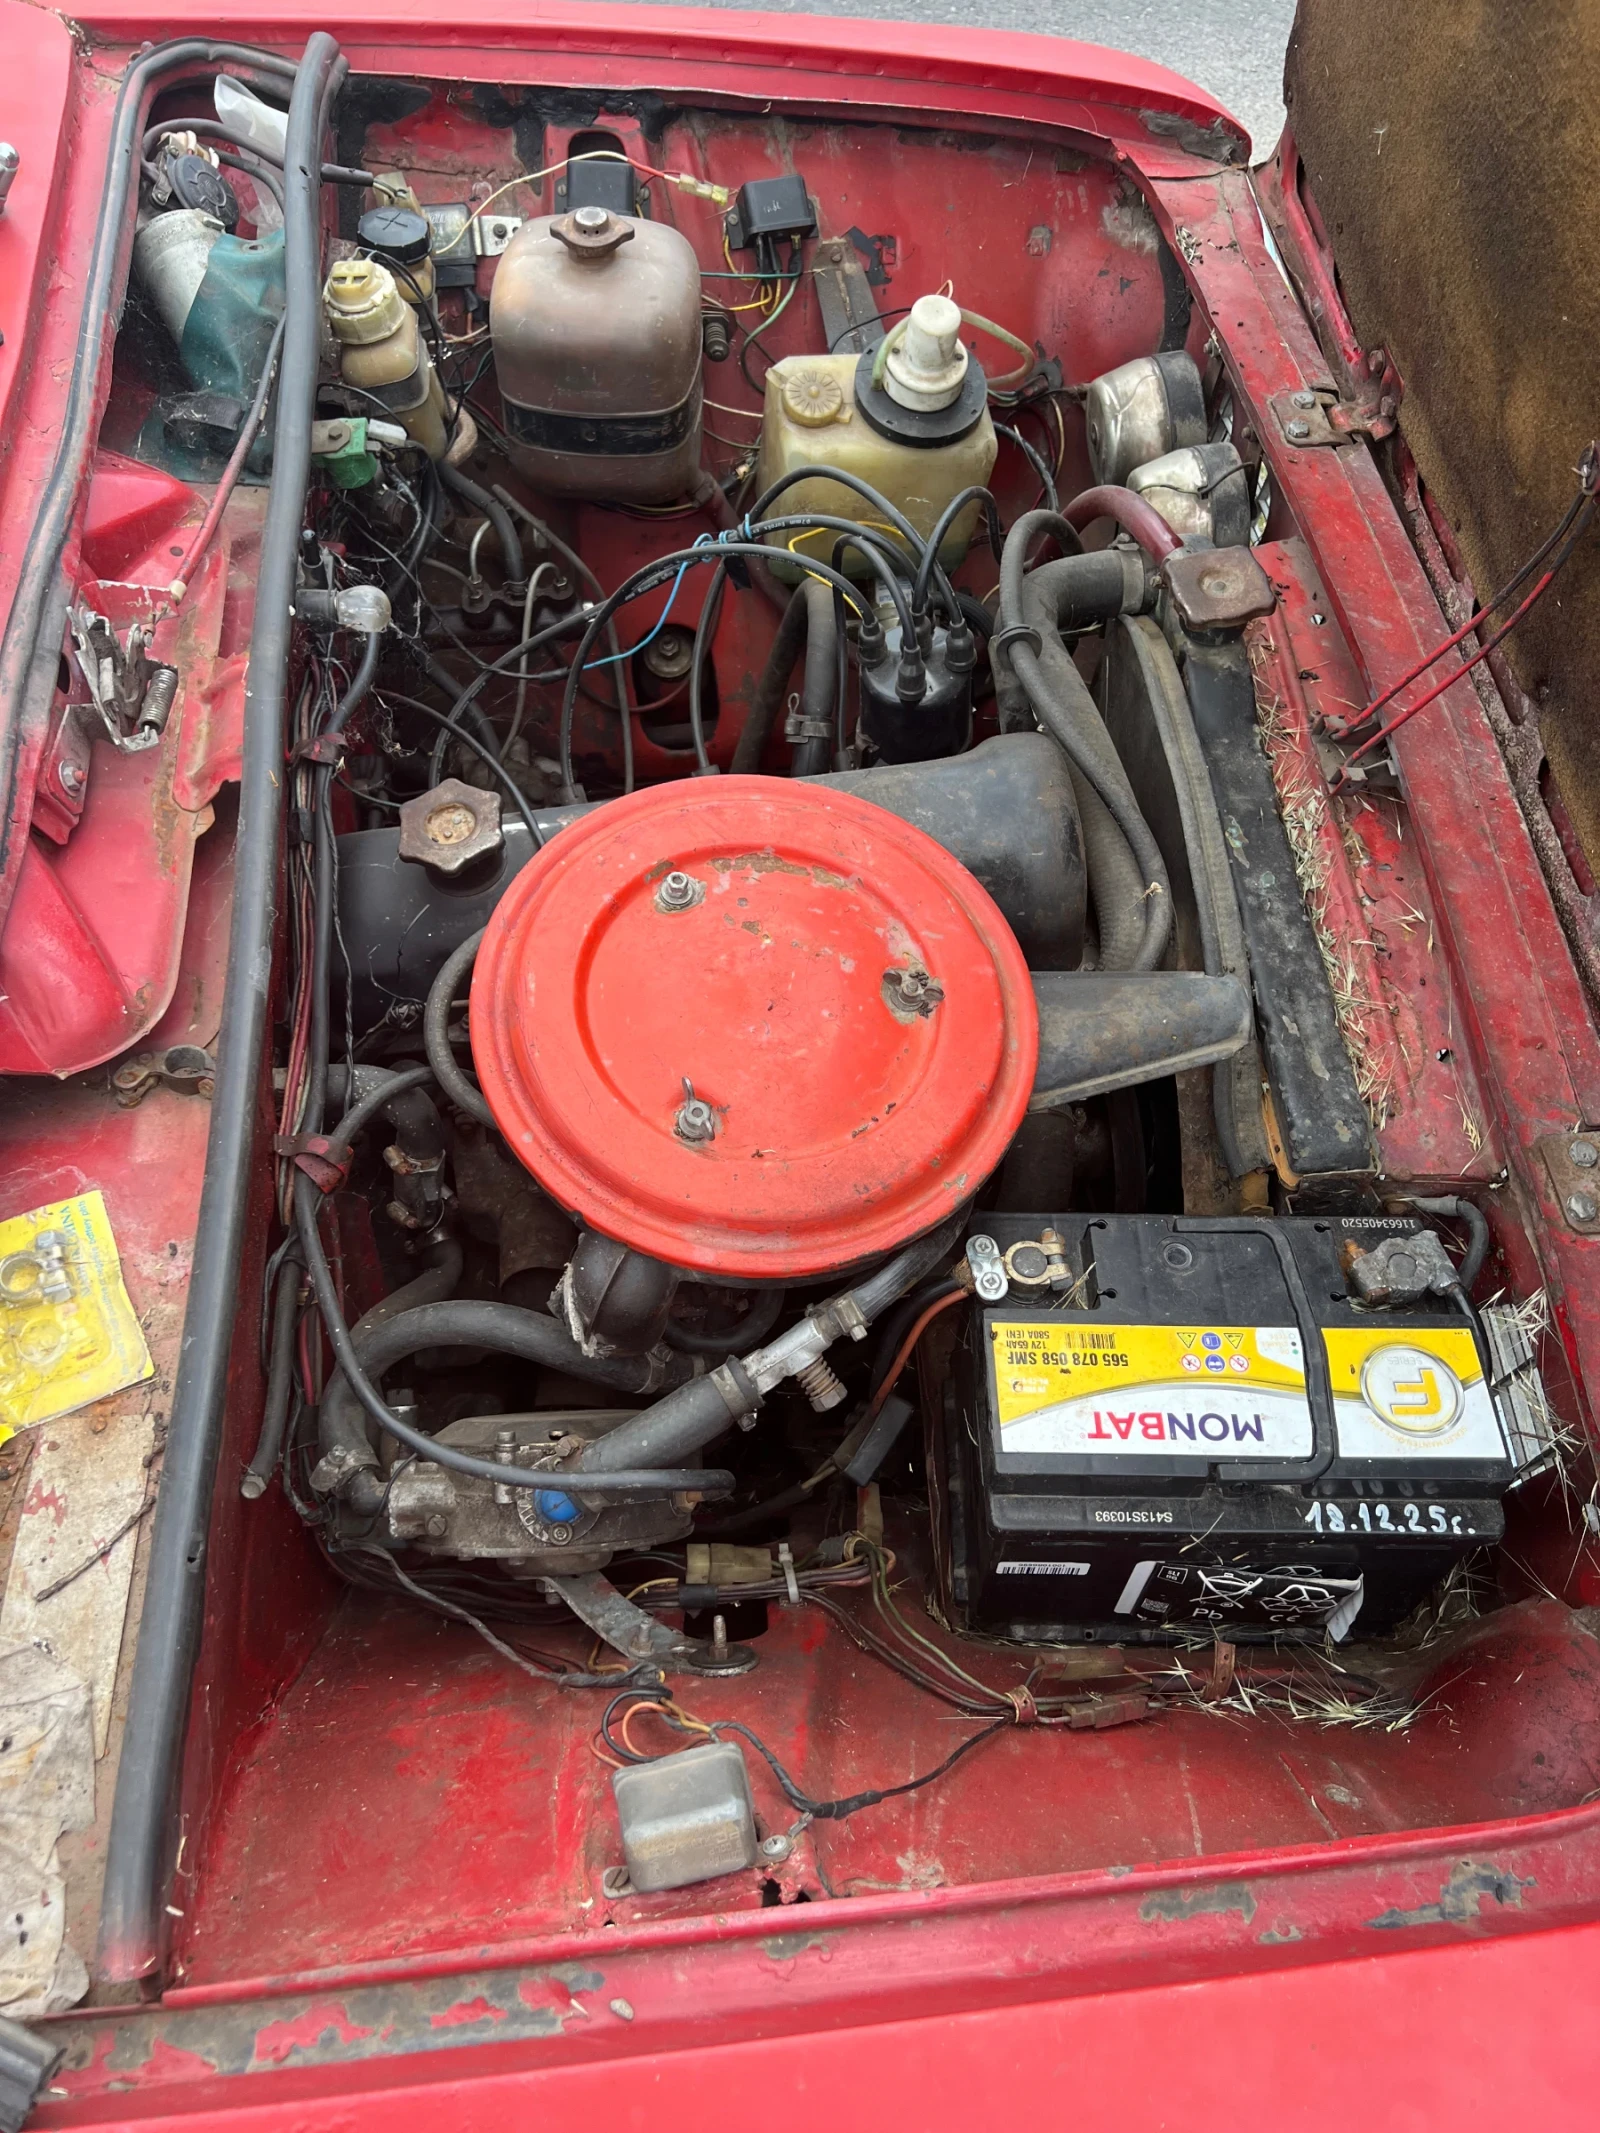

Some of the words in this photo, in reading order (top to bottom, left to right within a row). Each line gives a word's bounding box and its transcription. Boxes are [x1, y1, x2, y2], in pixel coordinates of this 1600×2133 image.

[1341, 1217, 1416, 1229] 11663405520
[1006, 1329, 1025, 1339] (EN)
[1006, 1340, 1028, 1350] 65Ah
[1031, 1340, 1047, 1350] 12V
[1007, 1351, 1036, 1365] SMF
[1042, 1352, 1068, 1365] 058
[1072, 1352, 1098, 1366] 078
[1102, 1353, 1129, 1367] 565
[1387, 1356, 1423, 1366] SERIES
[1390, 1368, 1442, 1416] F
[1087, 1411, 1265, 1442] MONBAT
[1095, 1510, 1173, 1523] S413S10393
[1192, 1607, 1223, 1620] Pb
